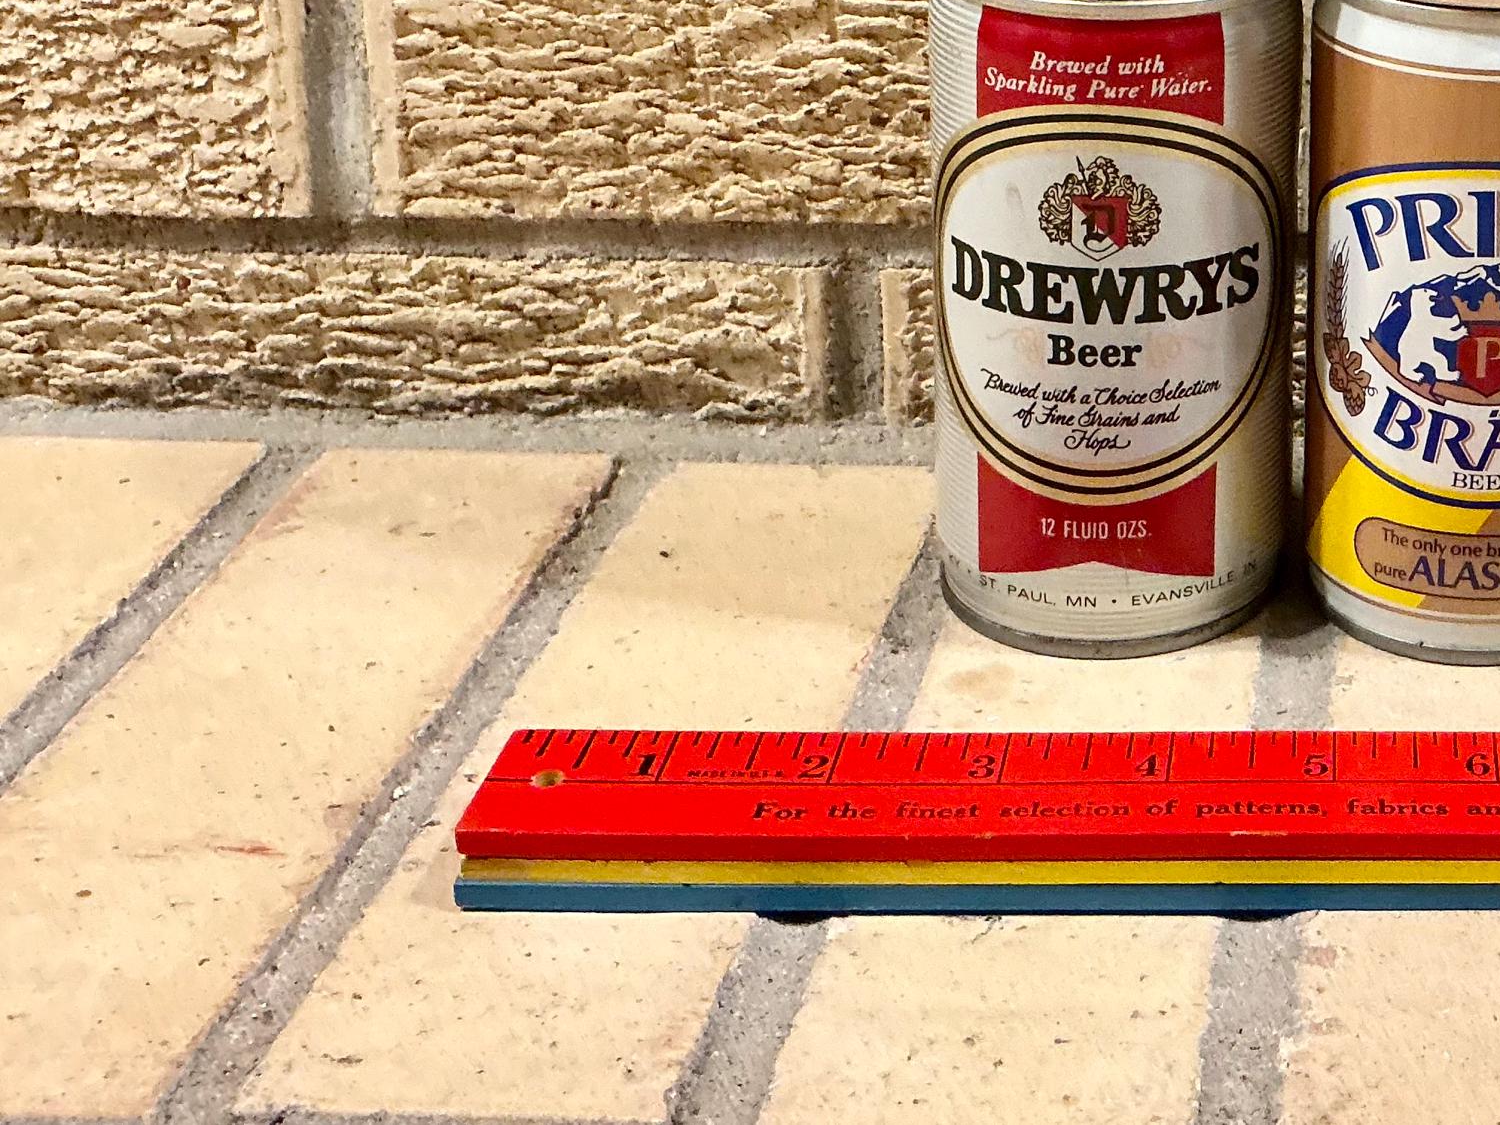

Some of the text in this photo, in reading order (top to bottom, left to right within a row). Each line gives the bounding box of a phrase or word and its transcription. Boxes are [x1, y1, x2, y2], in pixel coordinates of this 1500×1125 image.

[1030, 50, 1165, 75] Brewed with
[984, 67, 1212, 101] Sparkling Pure Water.
[951, 235, 1259, 325] DREWRYS
[1047, 334, 1142, 367] Beer
[980, 368, 1221, 407] Brewed with a Choice Selection
[1013, 405, 1180, 428] of Fine Grains and
[1064, 428, 1131, 457] Hops
[1041, 517, 1152, 540] 12 FLUID OZS.
[1382, 527, 1408, 548] The
[1412, 537, 1446, 558] only
[1450, 543, 1482, 557] one
[1374, 561, 1407, 580] pure
[978, 574, 1000, 593] ST.
[1008, 584, 1057, 607] PAUL,
[1066, 595, 1098, 608] MN
[1131, 570, 1235, 607] EVANSVILLE
[628, 752, 659, 777] 1
[797, 754, 830, 779] 2
[968, 754, 997, 779] 3
[1135, 754, 1160, 777] 4
[1303, 754, 1330, 776] 5
[1465, 753, 1491, 776] 6
[752, 801, 805, 821] For
[827, 801, 876, 820] the
[895, 801, 980, 820] finest
[1000, 799, 1131, 819] selection
[1145, 799, 1178, 818] of
[1195, 800, 1328, 819] patterns,
[1347, 799, 1449, 818] fabrics
